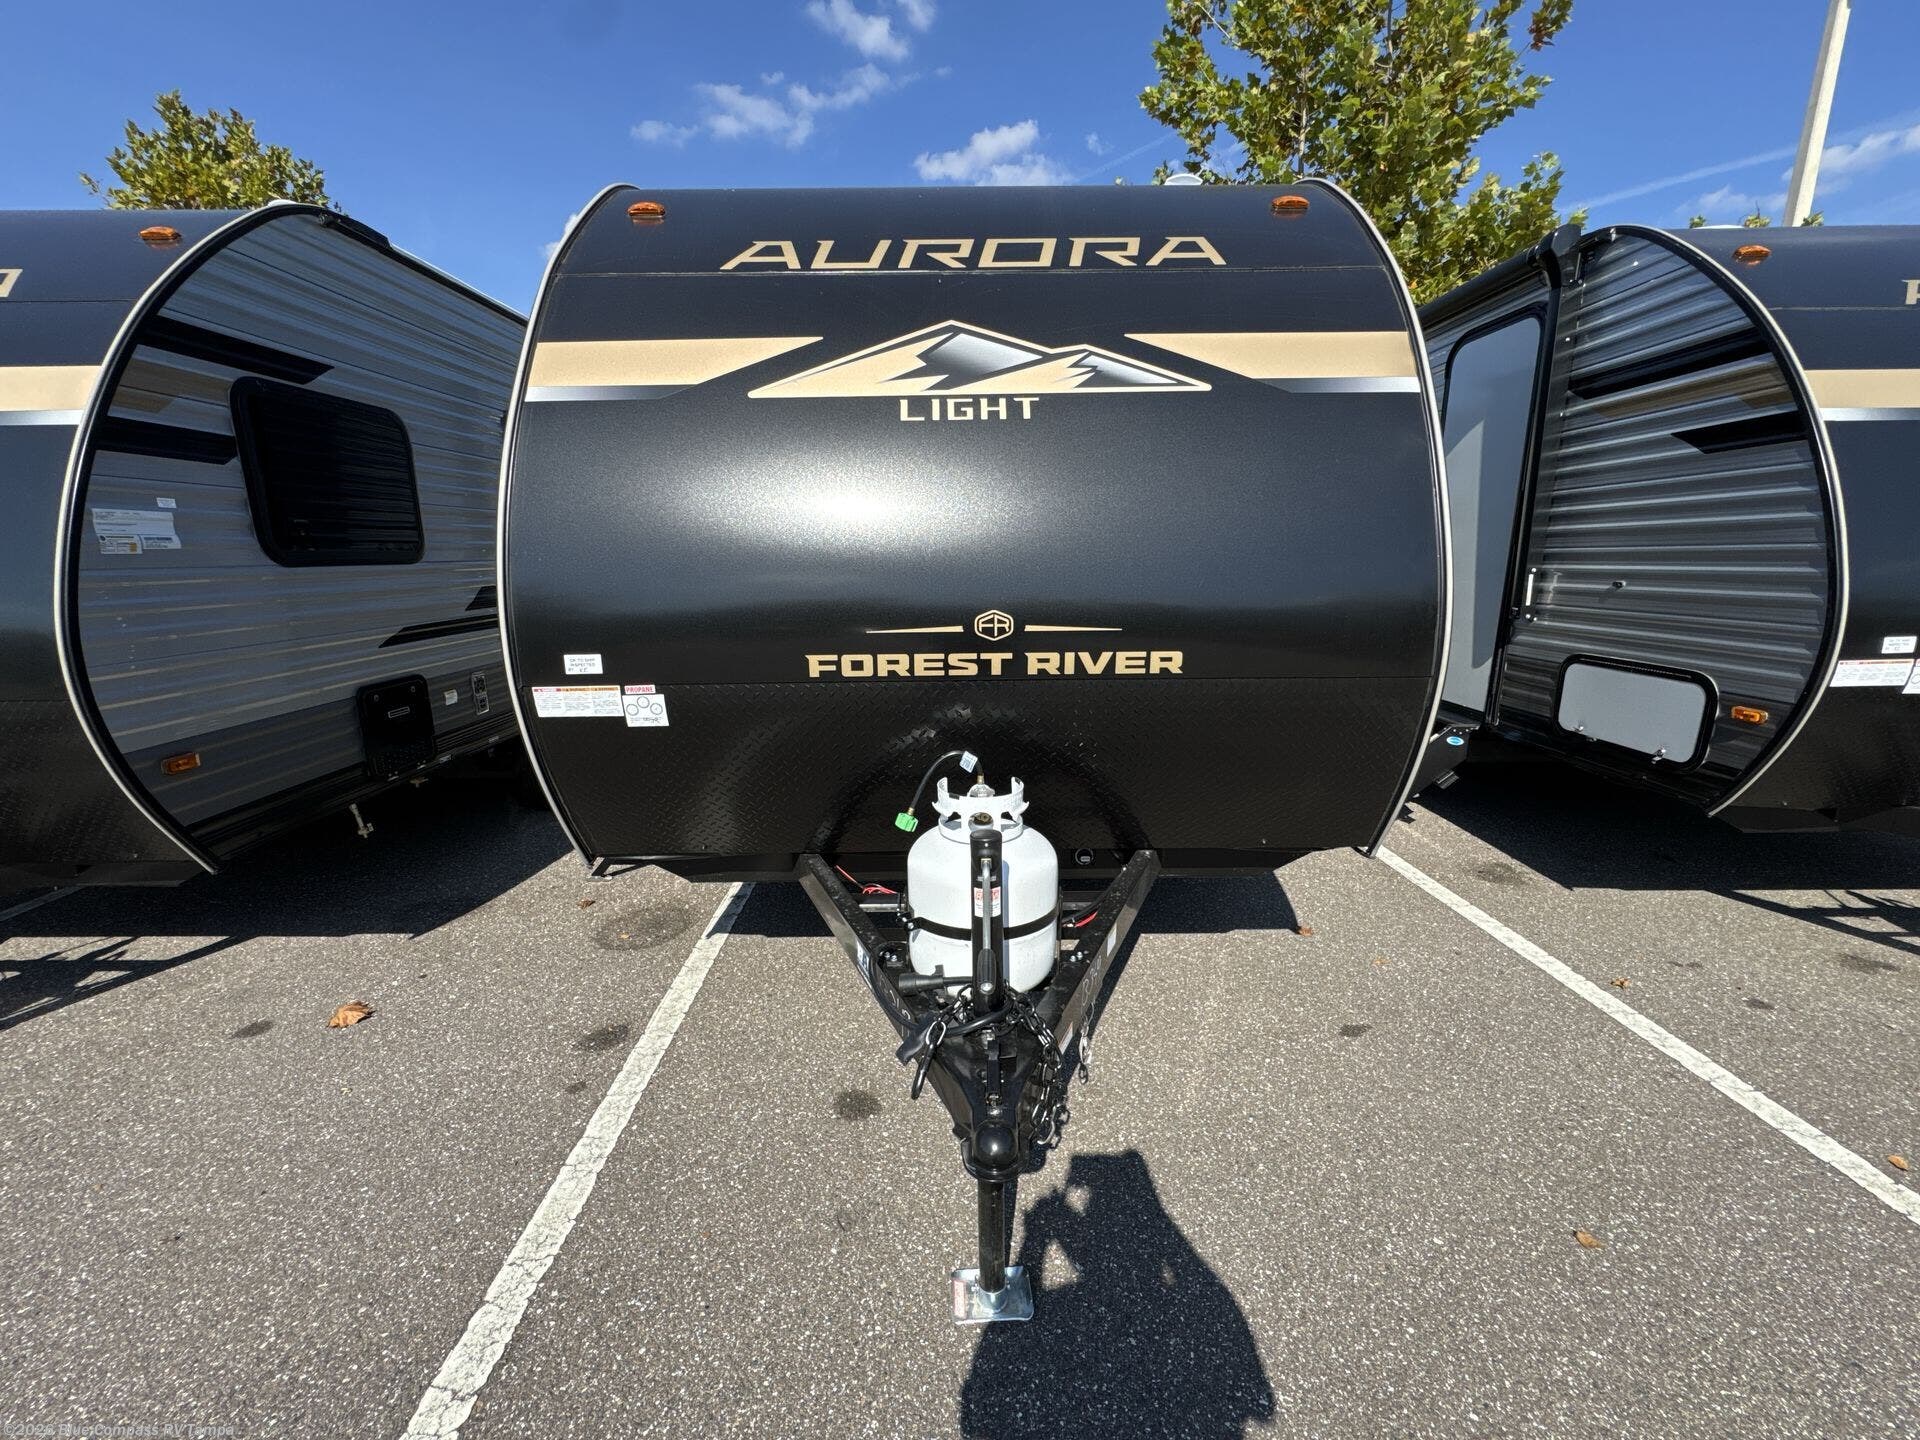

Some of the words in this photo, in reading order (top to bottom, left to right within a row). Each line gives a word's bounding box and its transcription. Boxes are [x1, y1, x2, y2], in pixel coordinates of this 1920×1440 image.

[720, 236, 1227, 270] AURORA
[900, 397, 1040, 421] LIGHT
[805, 652, 1013, 678] FOREST
[1024, 651, 1184, 675] RIVER
